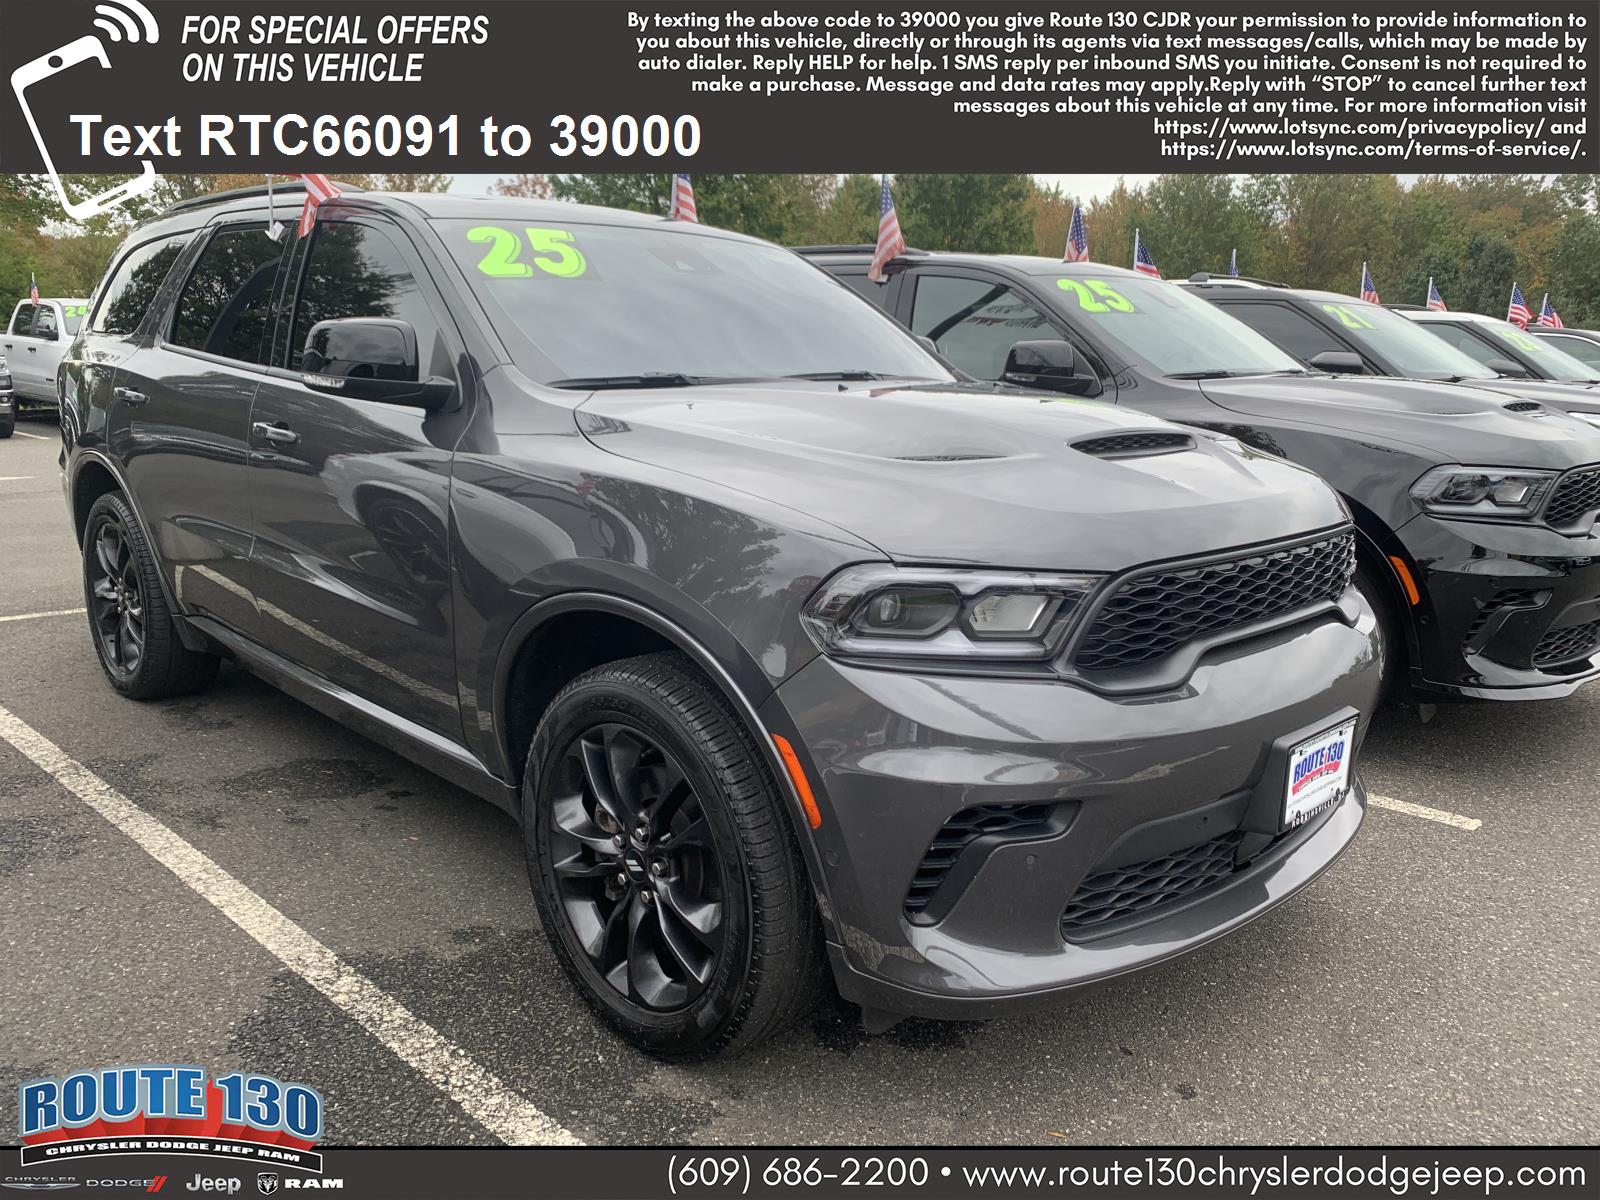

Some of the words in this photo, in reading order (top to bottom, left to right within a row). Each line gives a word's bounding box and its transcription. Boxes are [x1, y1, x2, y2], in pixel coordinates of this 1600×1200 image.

[466, 226, 587, 279] 25
[1057, 278, 1135, 314] 25
[1293, 747, 1326, 785] ROUTE
[1327, 740, 1346, 763] 130
